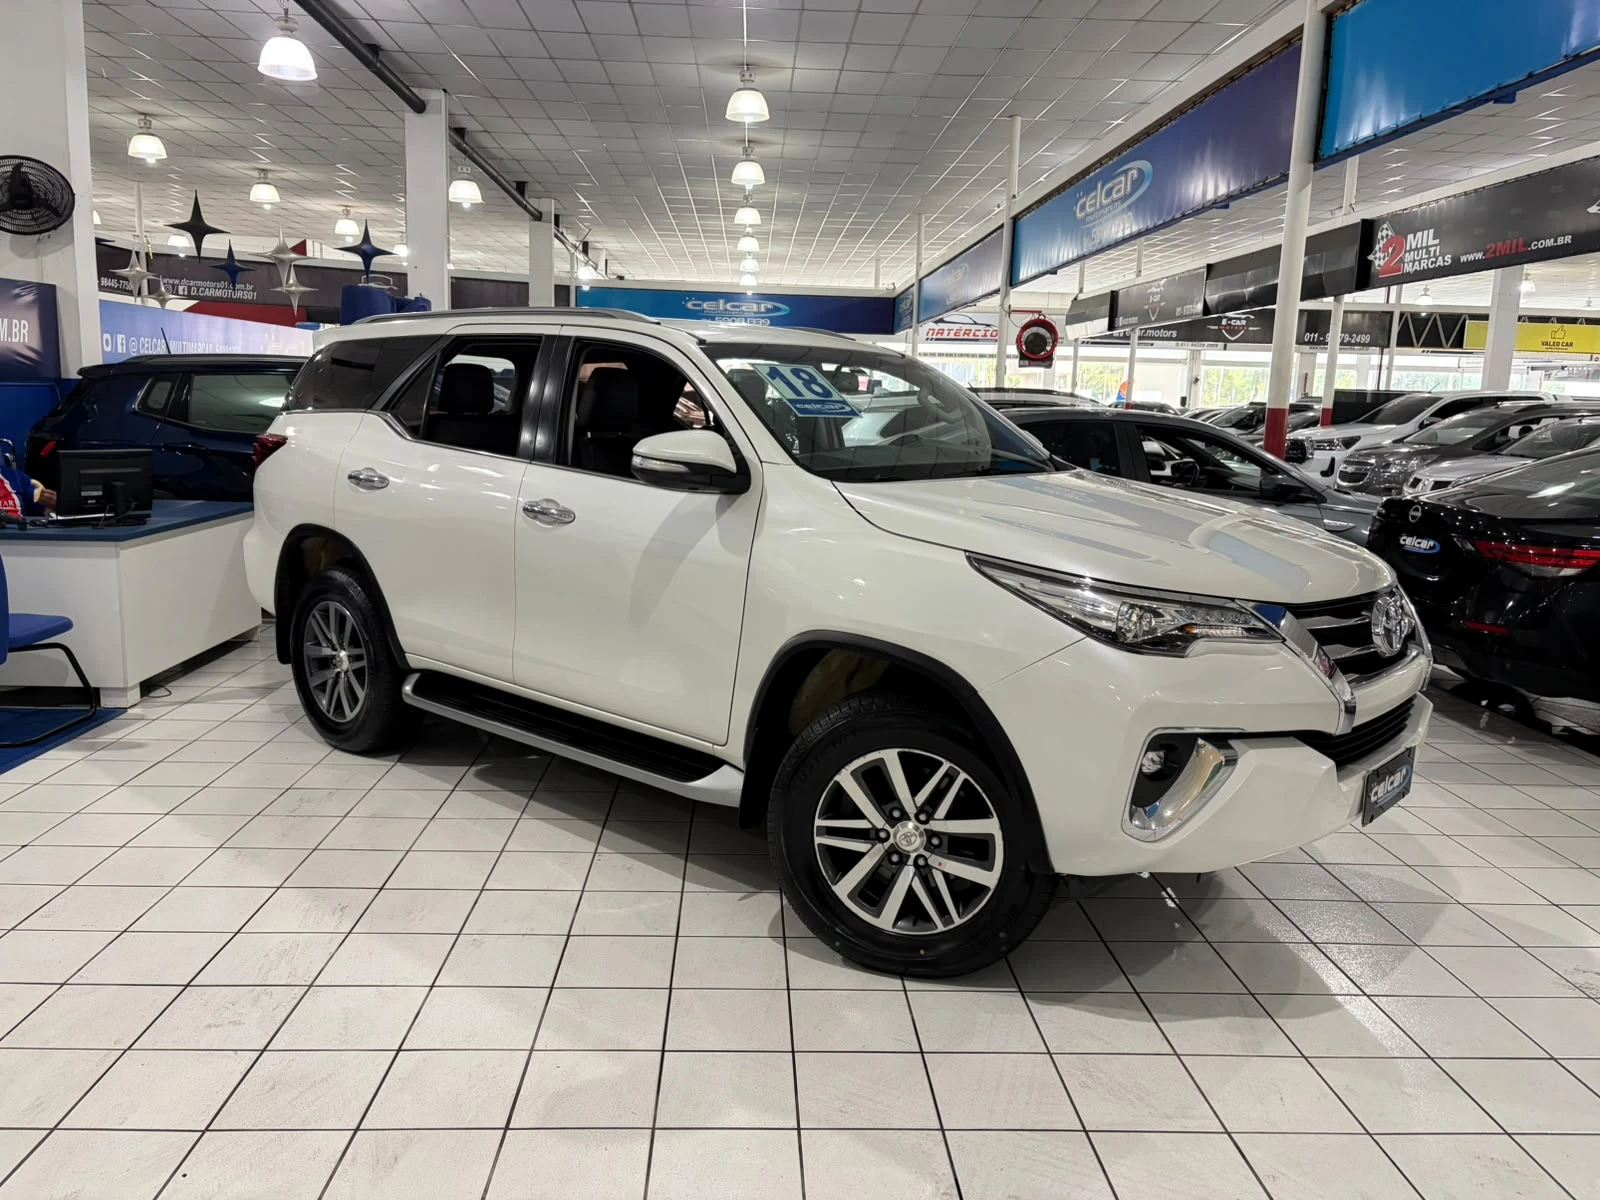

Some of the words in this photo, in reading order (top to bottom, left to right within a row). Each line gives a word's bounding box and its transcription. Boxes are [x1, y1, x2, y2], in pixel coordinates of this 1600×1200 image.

[1076, 168, 1138, 220] celcar
[1379, 235, 1406, 277] 2
[1406, 228, 1440, 250] MIL
[1404, 246, 1440, 263] MULTI
[1403, 254, 1452, 274] MARCAS
[686, 299, 774, 313] celcar
[1304, 332, 1318, 342] 011
[766, 366, 833, 398] 18
[1400, 535, 1434, 549] celcar
[1371, 766, 1407, 803] celcar
